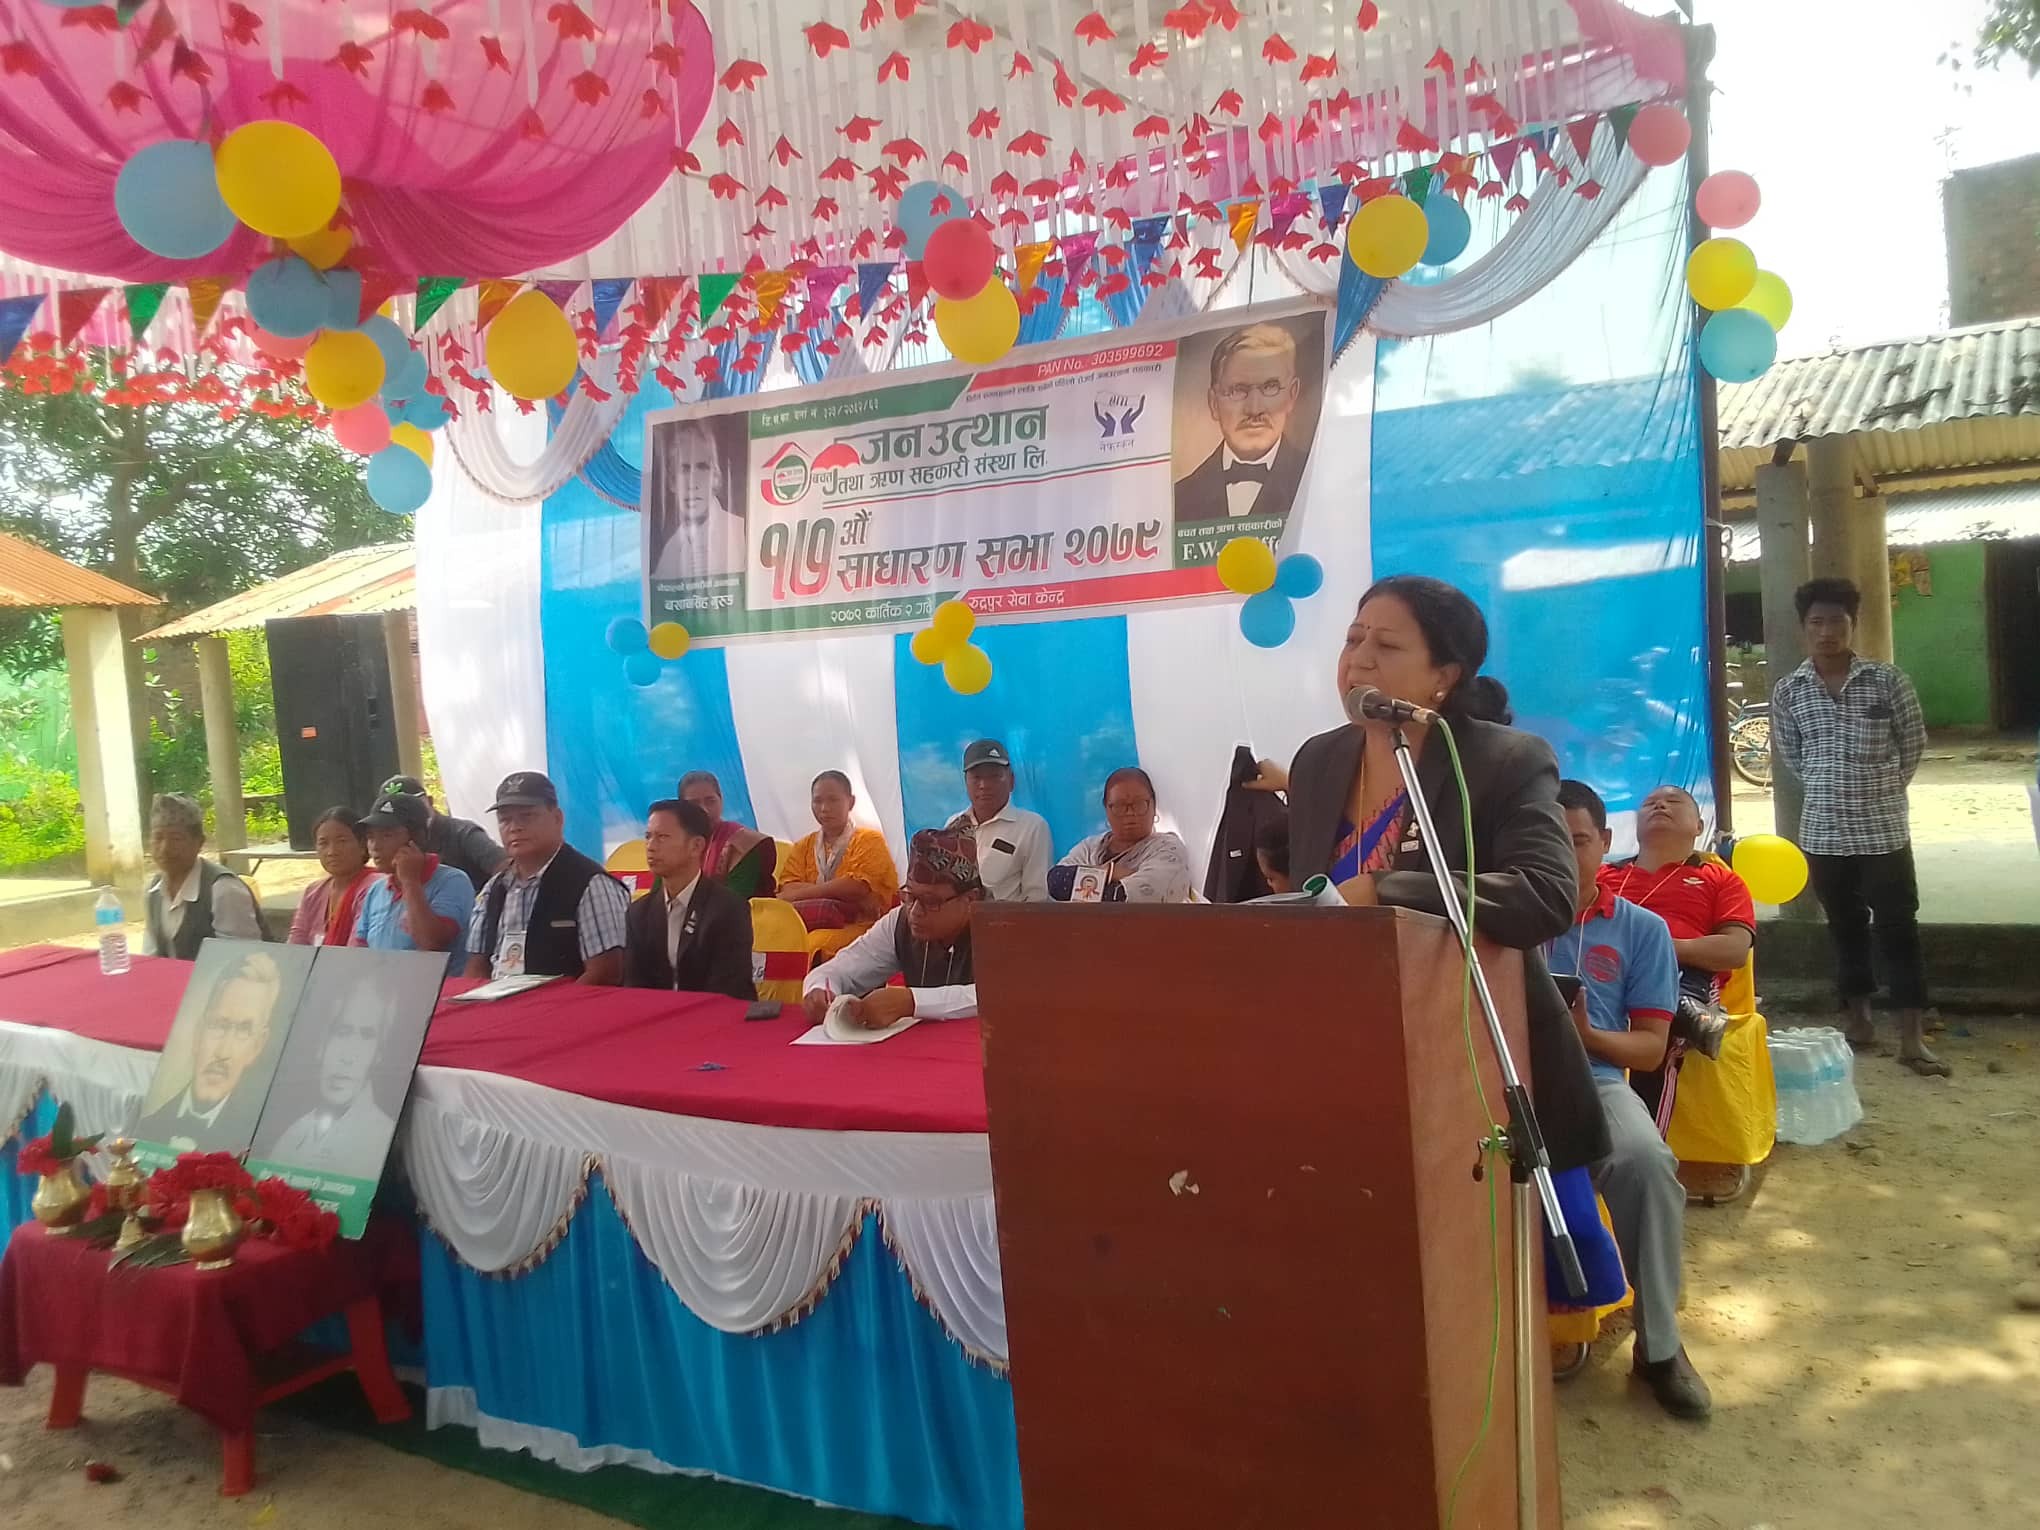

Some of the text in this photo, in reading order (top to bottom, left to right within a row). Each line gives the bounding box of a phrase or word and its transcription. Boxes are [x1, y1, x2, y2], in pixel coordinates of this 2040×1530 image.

[1037, 360, 1061, 377] PAN
[1091, 343, 1164, 366] 303599692
[846, 404, 1050, 465] जन उत्थान
[837, 473, 863, 494] तथा
[869, 469, 904, 489] ऋण
[910, 455, 969, 486] सहकारी
[973, 450, 1017, 479] संस्था
[759, 516, 837, 601] १७
[836, 540, 967, 594] साधारण
[975, 531, 1054, 578] सभा
[1063, 519, 1161, 567] २०७९
[830, 608, 863, 622] २०७९
[865, 600, 903, 620] कार्तिक
[904, 604, 912, 617] २
[967, 586, 1066, 612] रुद्रपुर सेवा केन्द्र
